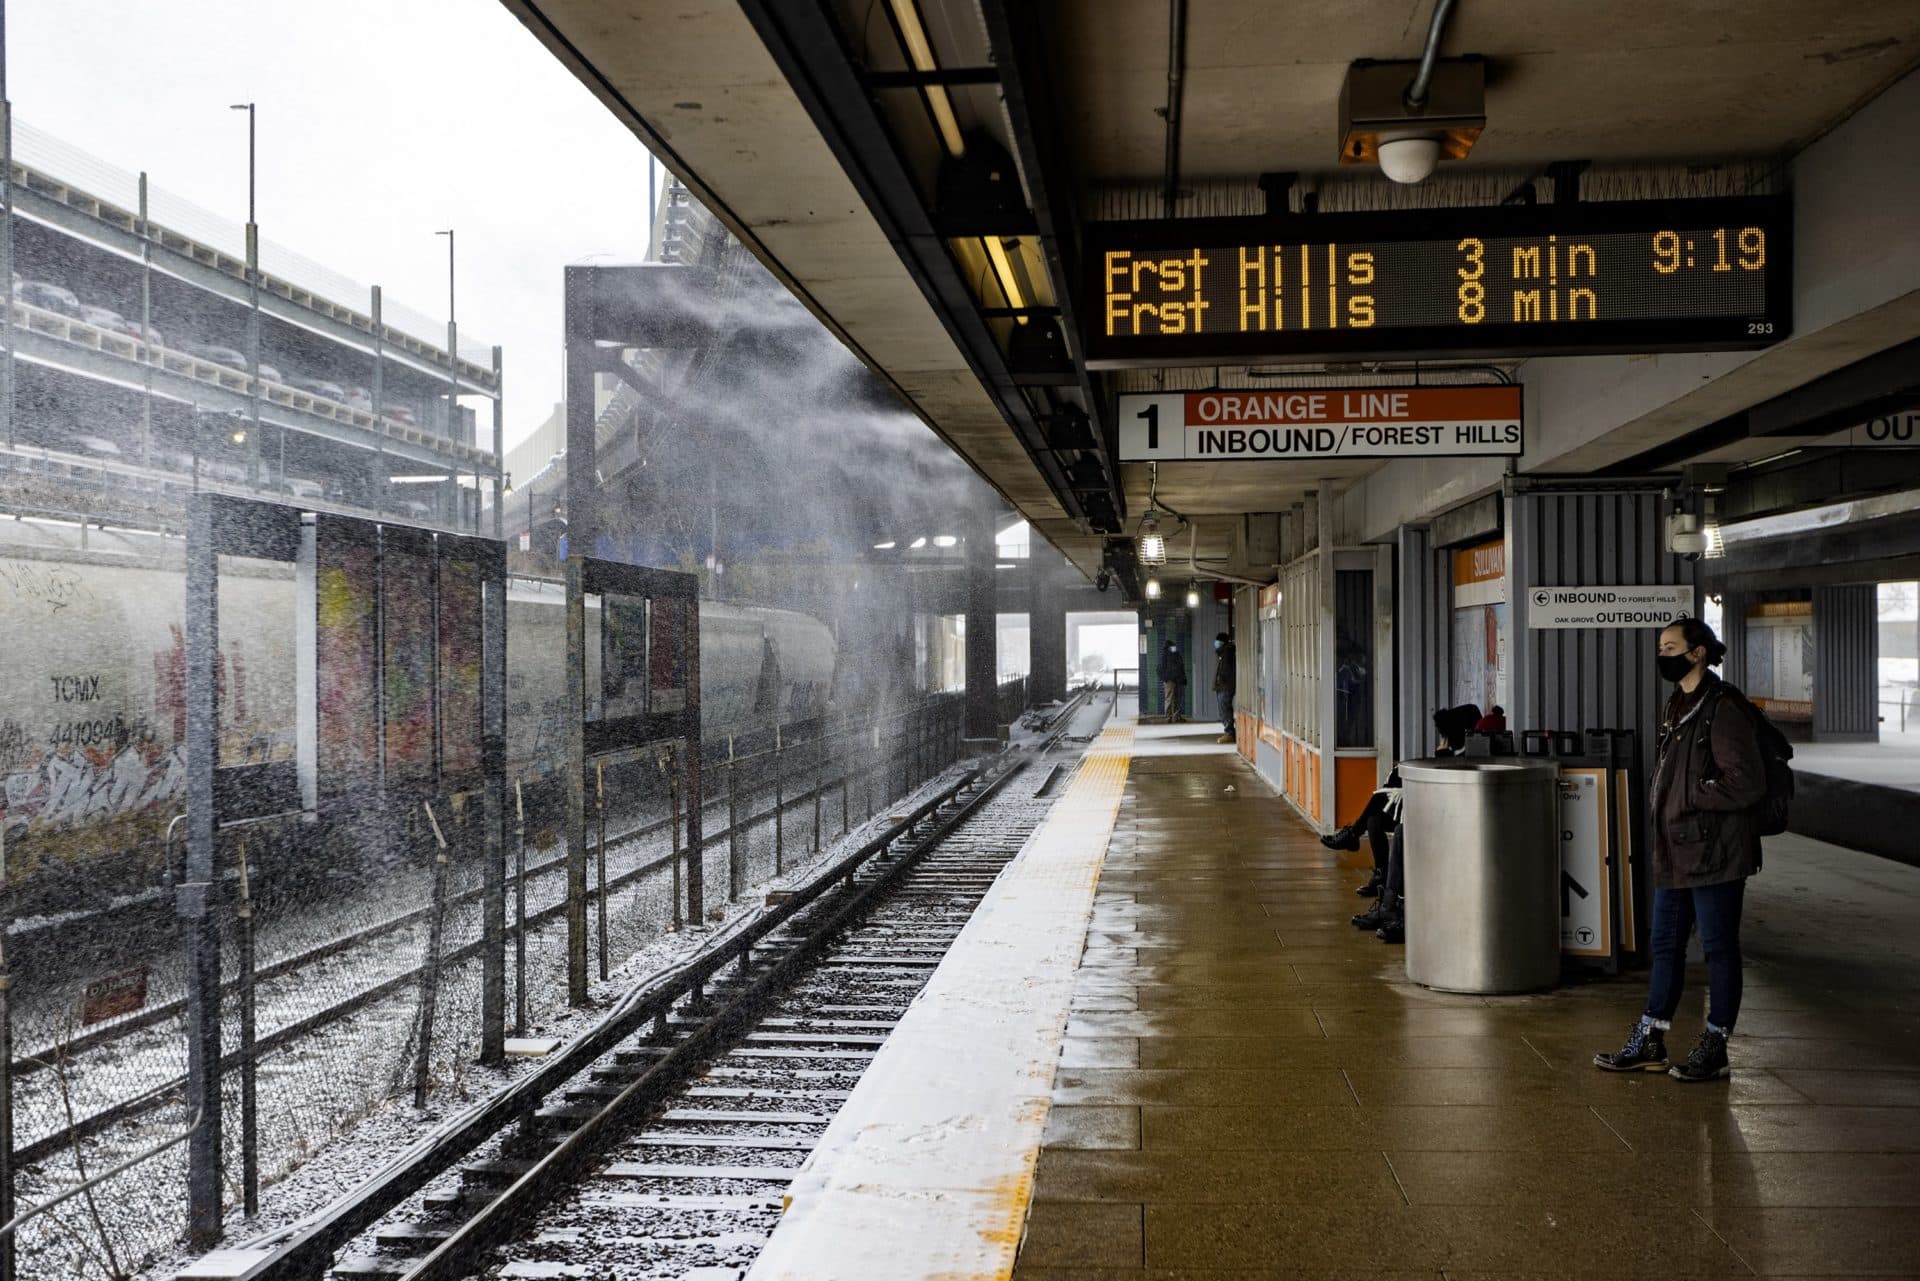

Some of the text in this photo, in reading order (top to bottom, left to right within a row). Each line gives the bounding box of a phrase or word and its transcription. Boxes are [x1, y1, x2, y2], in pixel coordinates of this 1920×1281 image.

[1106, 226, 1766, 293] Frst Hills 3 min 9:19
[1106, 277, 1597, 336] Frst Hills 8 min
[1747, 322, 1774, 335] 293
[1198, 393, 1410, 422] ORANGE LINE
[1136, 403, 1160, 449] 1
[1455, 424, 1520, 444] HILLS
[1554, 592, 1617, 604] INBOUND
[1570, 616, 1595, 624] GROVE
[1596, 611, 1673, 623] OUTBOUND
[50, 675, 101, 703] TCMX
[1563, 793, 1581, 801] Only
